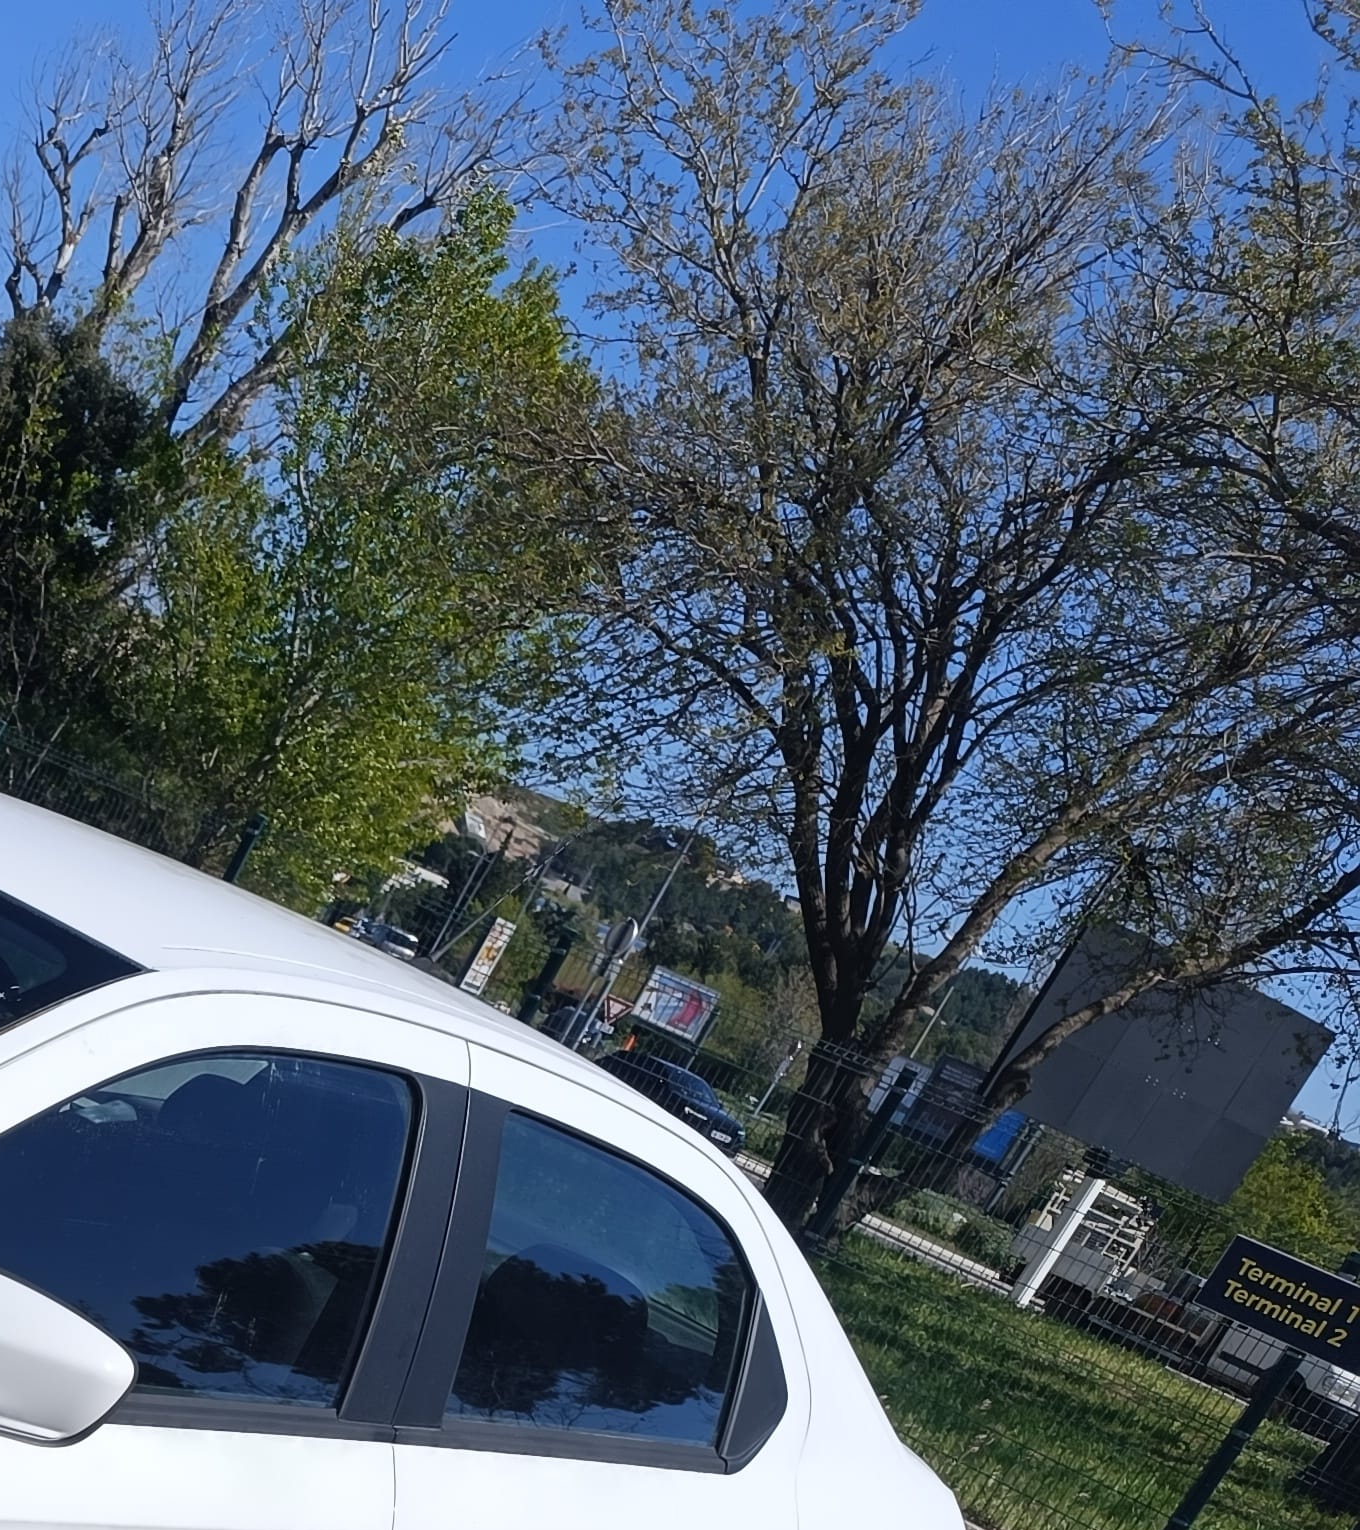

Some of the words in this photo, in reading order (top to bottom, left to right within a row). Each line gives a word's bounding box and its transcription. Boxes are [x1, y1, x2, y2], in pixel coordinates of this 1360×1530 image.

[1224, 1280, 1327, 1337] Terminal
[1326, 1328, 1349, 1348] 2
[1238, 1258, 1343, 1315] Terminal
[1346, 1304, 1360, 1324] 1
